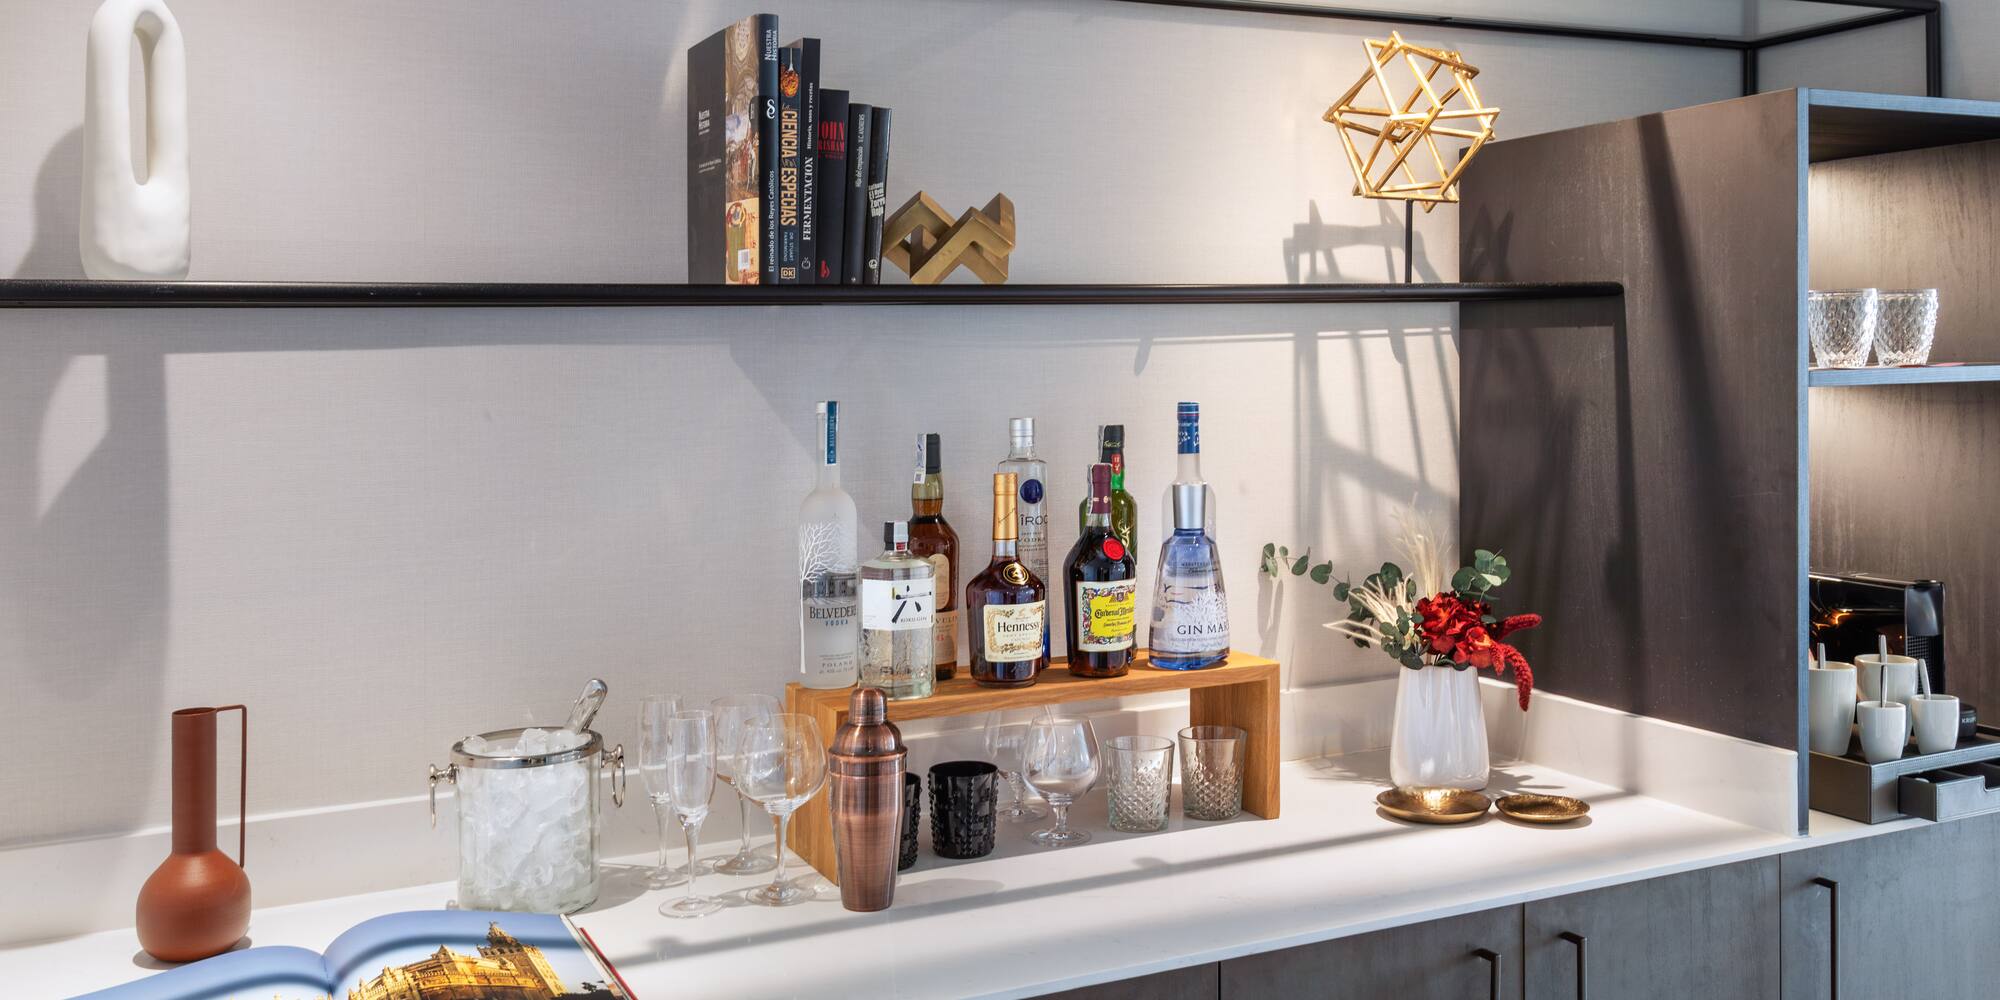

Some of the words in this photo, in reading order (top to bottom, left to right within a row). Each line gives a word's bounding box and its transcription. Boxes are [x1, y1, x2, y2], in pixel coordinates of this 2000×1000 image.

[764, 29, 772, 61] NUESTRA
[781, 111, 798, 158] CIENCIA
[780, 167, 798, 227] ESPECIAS
[768, 201, 776, 219] Reyes
[768, 230, 774, 239] de
[825, 619, 848, 627] VODKA
[997, 621, 1040, 632] Hennessy
[1176, 624, 1203, 635] GIN
